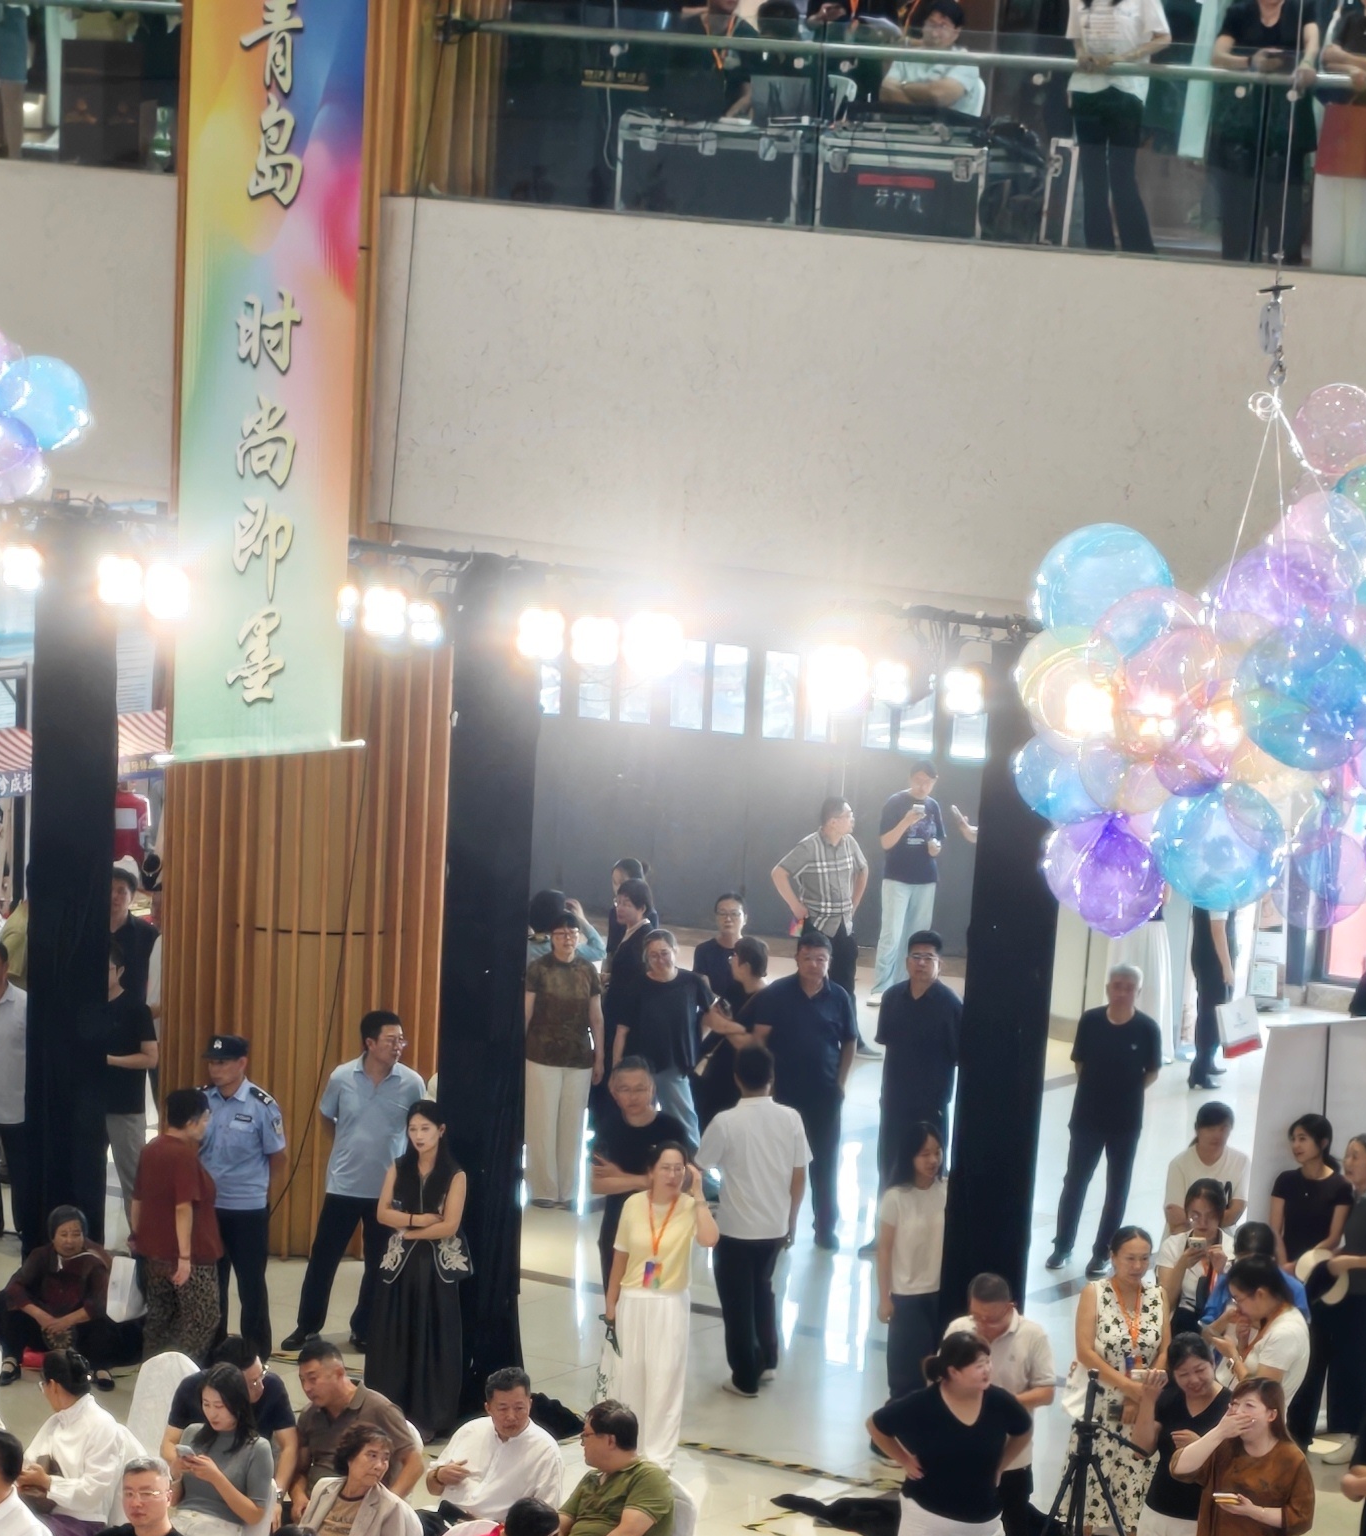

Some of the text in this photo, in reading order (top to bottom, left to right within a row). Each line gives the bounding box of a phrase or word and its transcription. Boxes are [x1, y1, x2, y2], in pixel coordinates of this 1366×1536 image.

[226, 0, 304, 703] 青岛 时尚即墨
